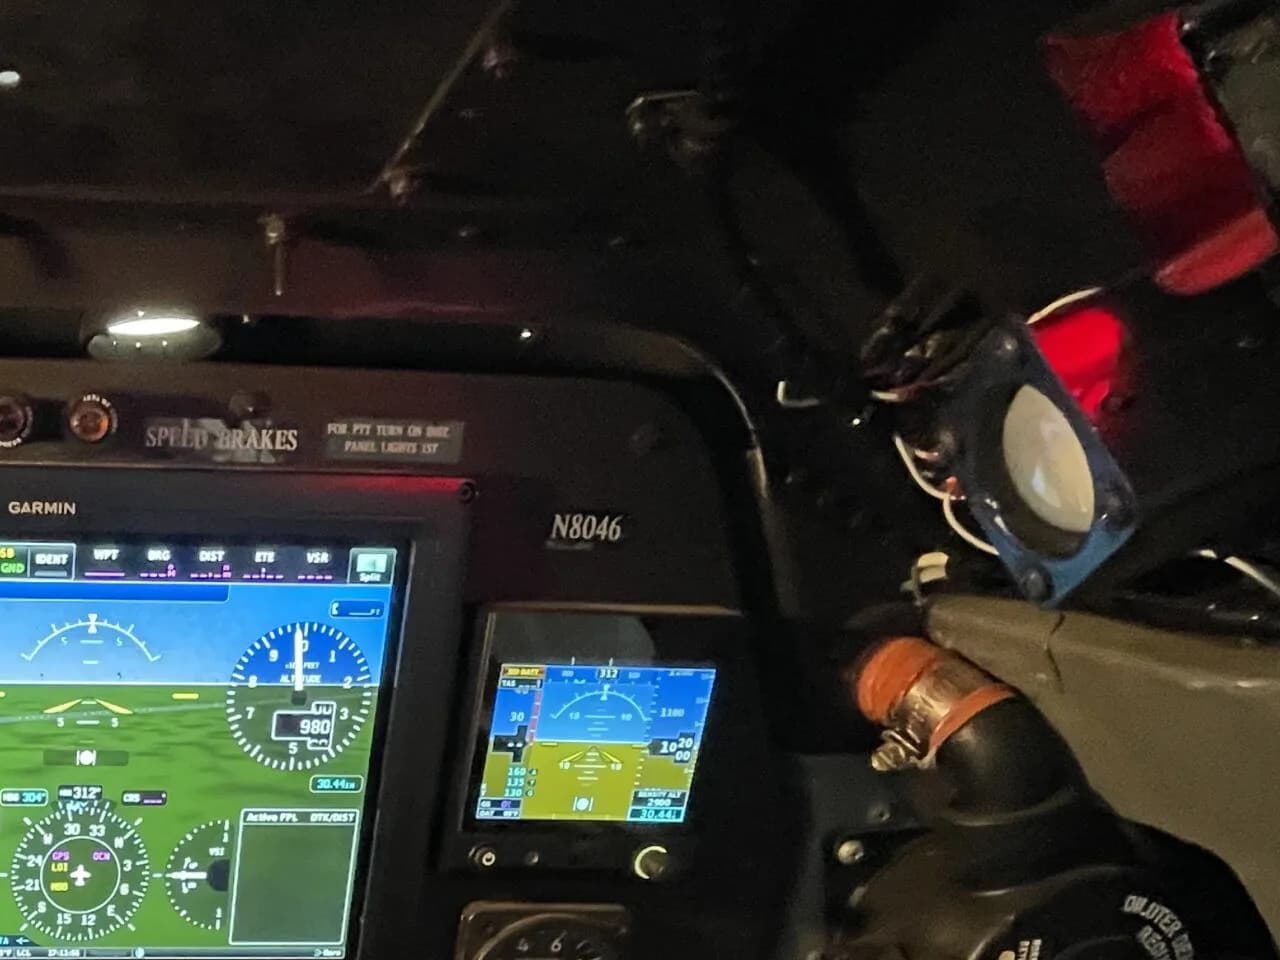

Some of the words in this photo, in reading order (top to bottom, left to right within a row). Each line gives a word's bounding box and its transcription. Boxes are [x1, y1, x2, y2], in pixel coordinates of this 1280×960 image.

[145, 426, 209, 450] SPEED
[219, 428, 298, 451] BRAKES
[8, 501, 76, 515] GARMIN
[551, 513, 622, 542] N8046
[36, 554, 68, 565] IDENT
[94, 549, 119, 560] WPT
[148, 550, 171, 561] BRG
[199, 551, 225, 563] DIST
[307, 552, 329, 564] VSR
[1, 563, 25, 573] GND
[269, 650, 278, 662] 9
[329, 651, 336, 662] 1
[599, 668, 618, 678] 312
[343, 676, 352, 688] 2
[246, 707, 255, 719] 7
[340, 707, 349, 720] 3
[510, 711, 524, 722] 30
[57, 718, 64, 727] 5
[111, 718, 118, 727] 5
[300, 720, 330, 734] 980
[289, 742, 298, 754] 5
[123, 793, 140, 802] CRS
[64, 824, 80, 836] 30
[89, 825, 105, 836] 33
[43, 834, 53, 845] W
[27, 855, 42, 867] 24
[123, 860, 132, 871] 3
[25, 879, 40, 890] 21
[38, 902, 46, 912] S
[107, 905, 115, 916] E
[57, 914, 71, 924] 15
[81, 914, 96, 925] 12
[551, 937, 561, 952] 6
